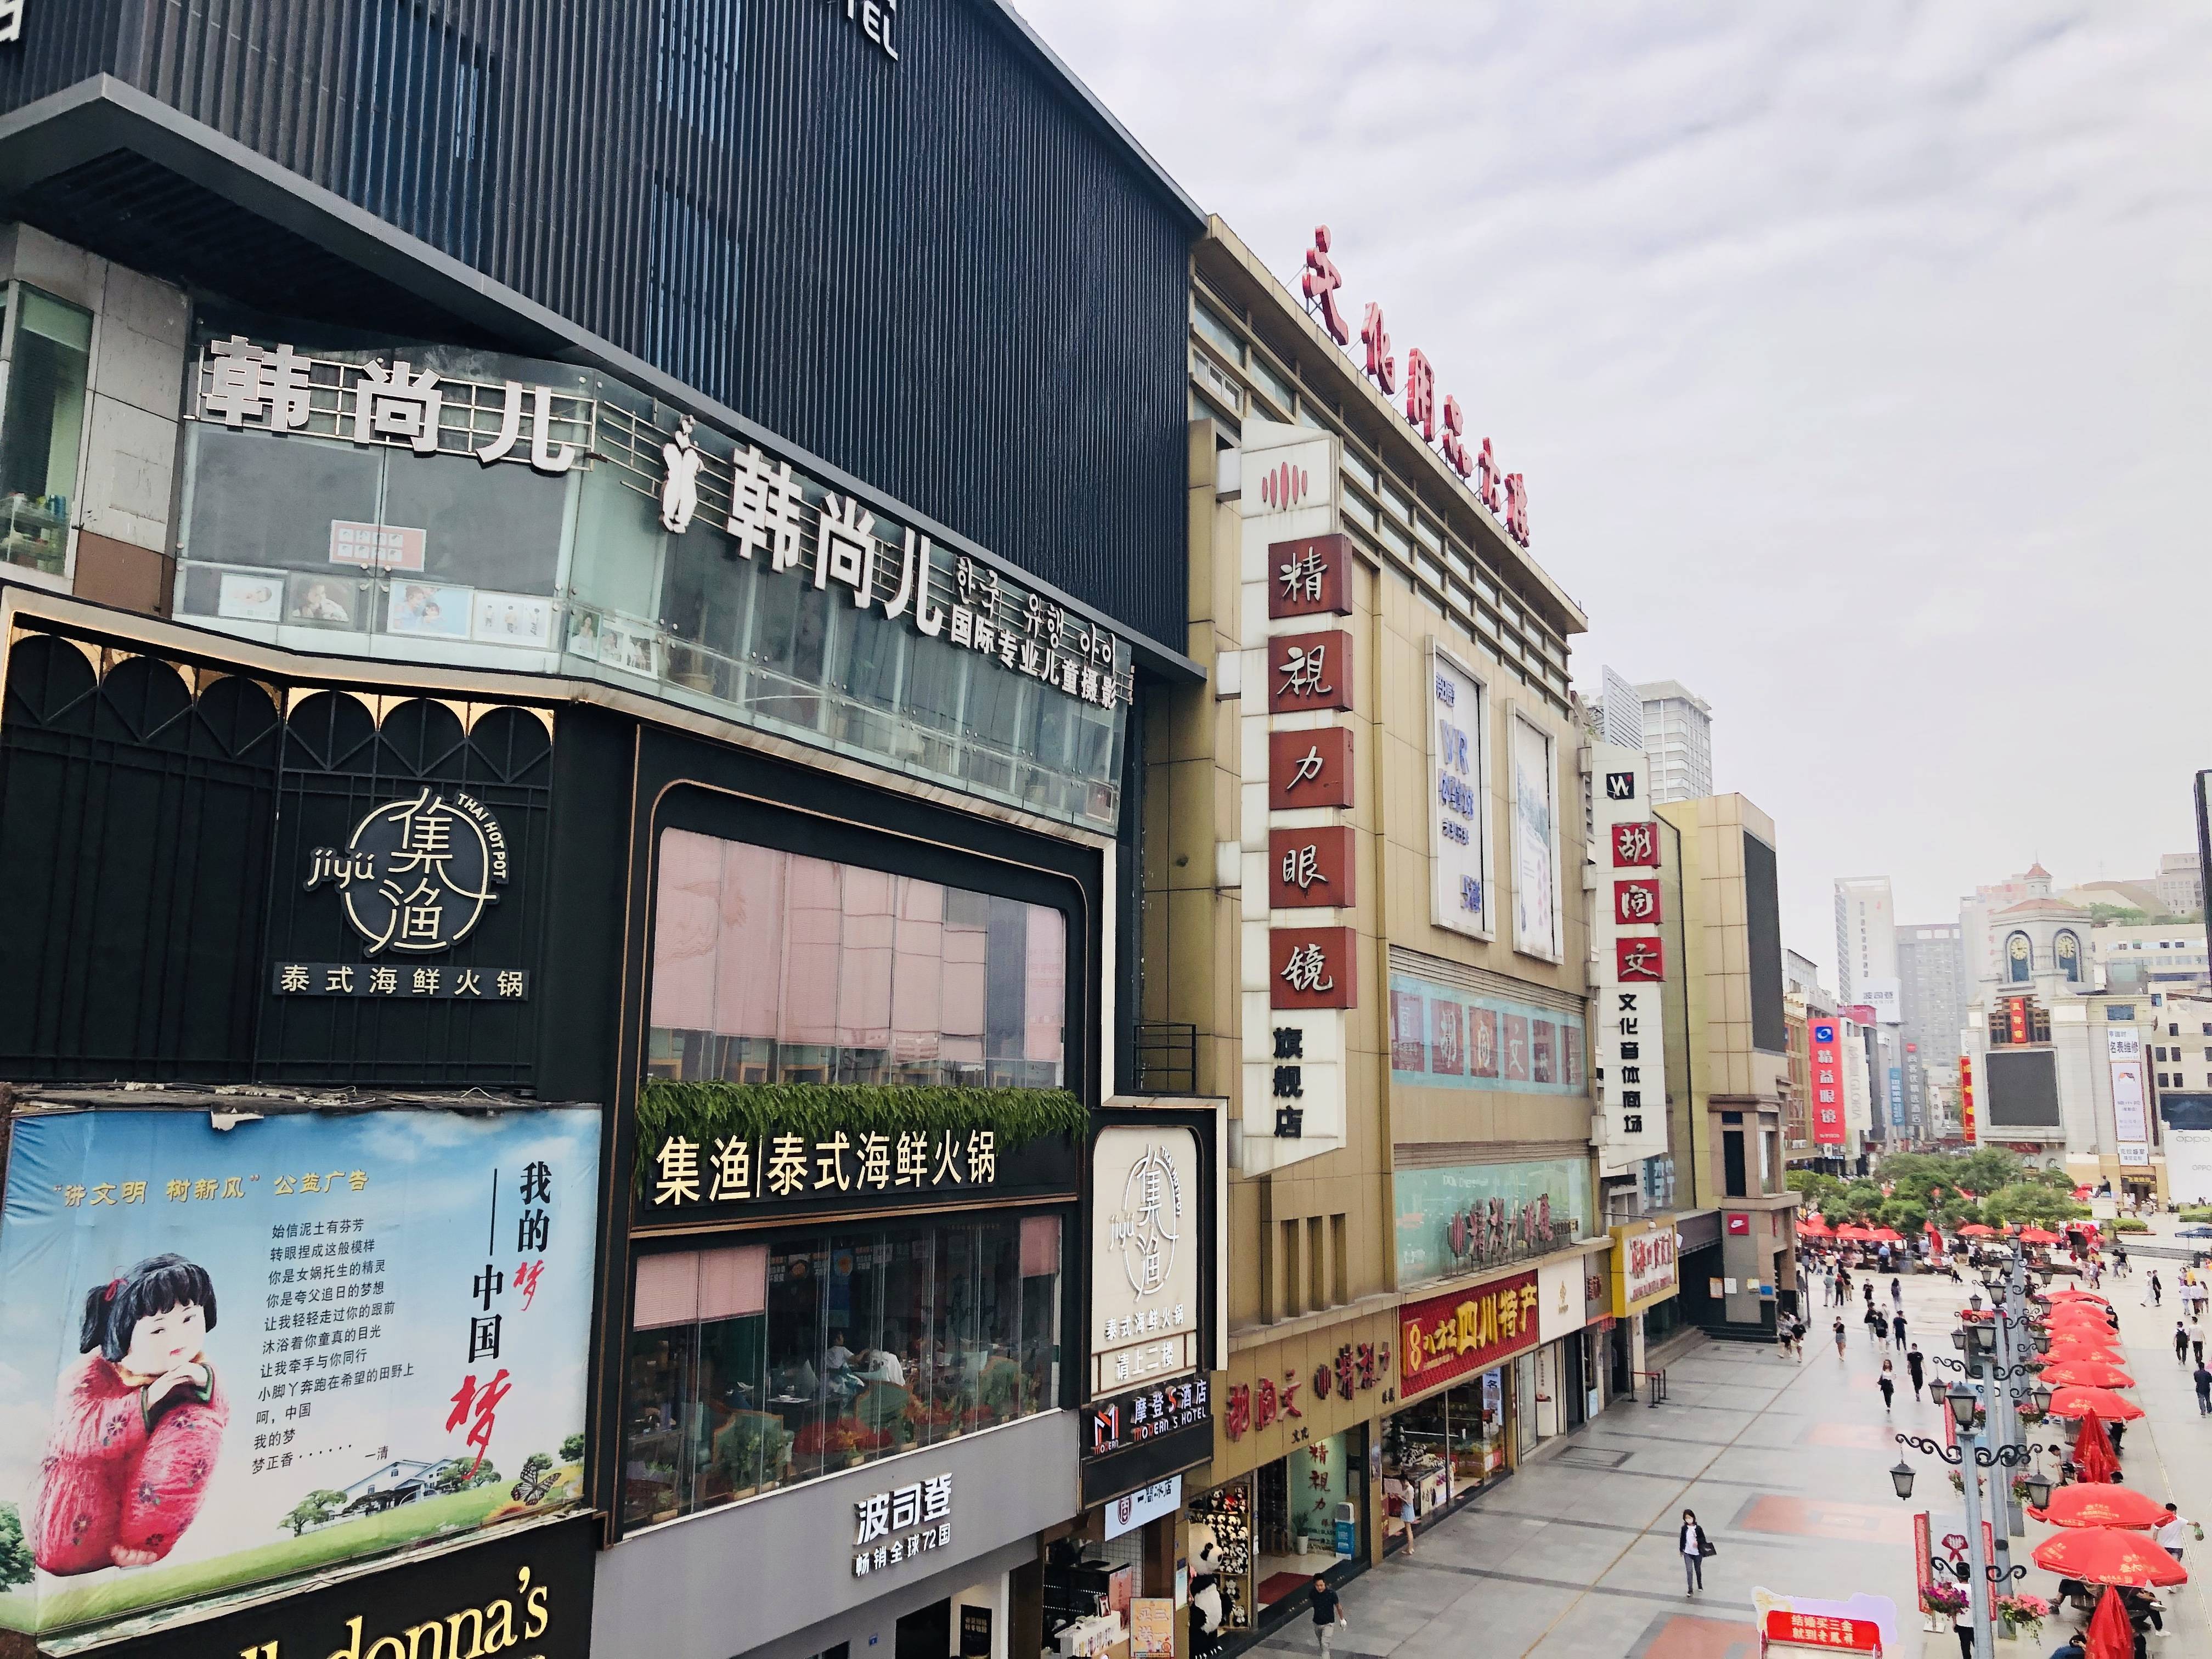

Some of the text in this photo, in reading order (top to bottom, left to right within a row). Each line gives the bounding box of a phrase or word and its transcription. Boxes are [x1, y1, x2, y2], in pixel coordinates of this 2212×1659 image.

[206, 335, 575, 472] 韩尚儿
[727, 444, 943, 637] 韩尚儿
[951, 604, 1117, 710] 国际专业儿童摄影
[1080, 623, 1116, 676] 아이
[458, 793, 488, 821] THAI
[280, 965, 523, 997] 泰式海鲜火锅
[1272, 1027, 1304, 1139] 旗舰店
[1618, 993, 1643, 1133] 文化音体商场
[1818, 1049, 1837, 1124] 精益眼镜
[274, 1169, 369, 1197] 公益广告
[654, 1130, 995, 1206] 集渔 泰式海鲜火锅
[272, 1218, 365, 1240] 始信泥土有芬芳
[513, 1160, 552, 1312] 我的梦
[270, 1239, 375, 1263] 转眼捏成这般模样
[268, 1260, 386, 1286] 你是女娲托生的精灵
[266, 1281, 385, 1310] 你是夸父追日的梦想
[264, 1301, 395, 1332] 让我轻轻走过你的跟前
[1104, 1302, 1184, 1342] 泰式海鲜火锅
[1456, 1282, 1537, 1356] 四川特产
[262, 1325, 381, 1356] 沐浴着你童真的目光
[260, 1348, 368, 1379] 让我牵手与你同行
[1114, 1341, 1175, 1381] 请上二楼
[257, 1363, 414, 1402] 小脚丫奔跑在希望的田野上
[1133, 1379, 1207, 1425] 摩登S酒店
[1181, 1406, 1207, 1426] HOTEL
[253, 1427, 296, 1451] 我的梦
[855, 1472, 953, 1545] 波司登
[855, 1522, 952, 1577] 畅销全球72国
[1791, 1613, 1853, 1633] 结婚买三金
